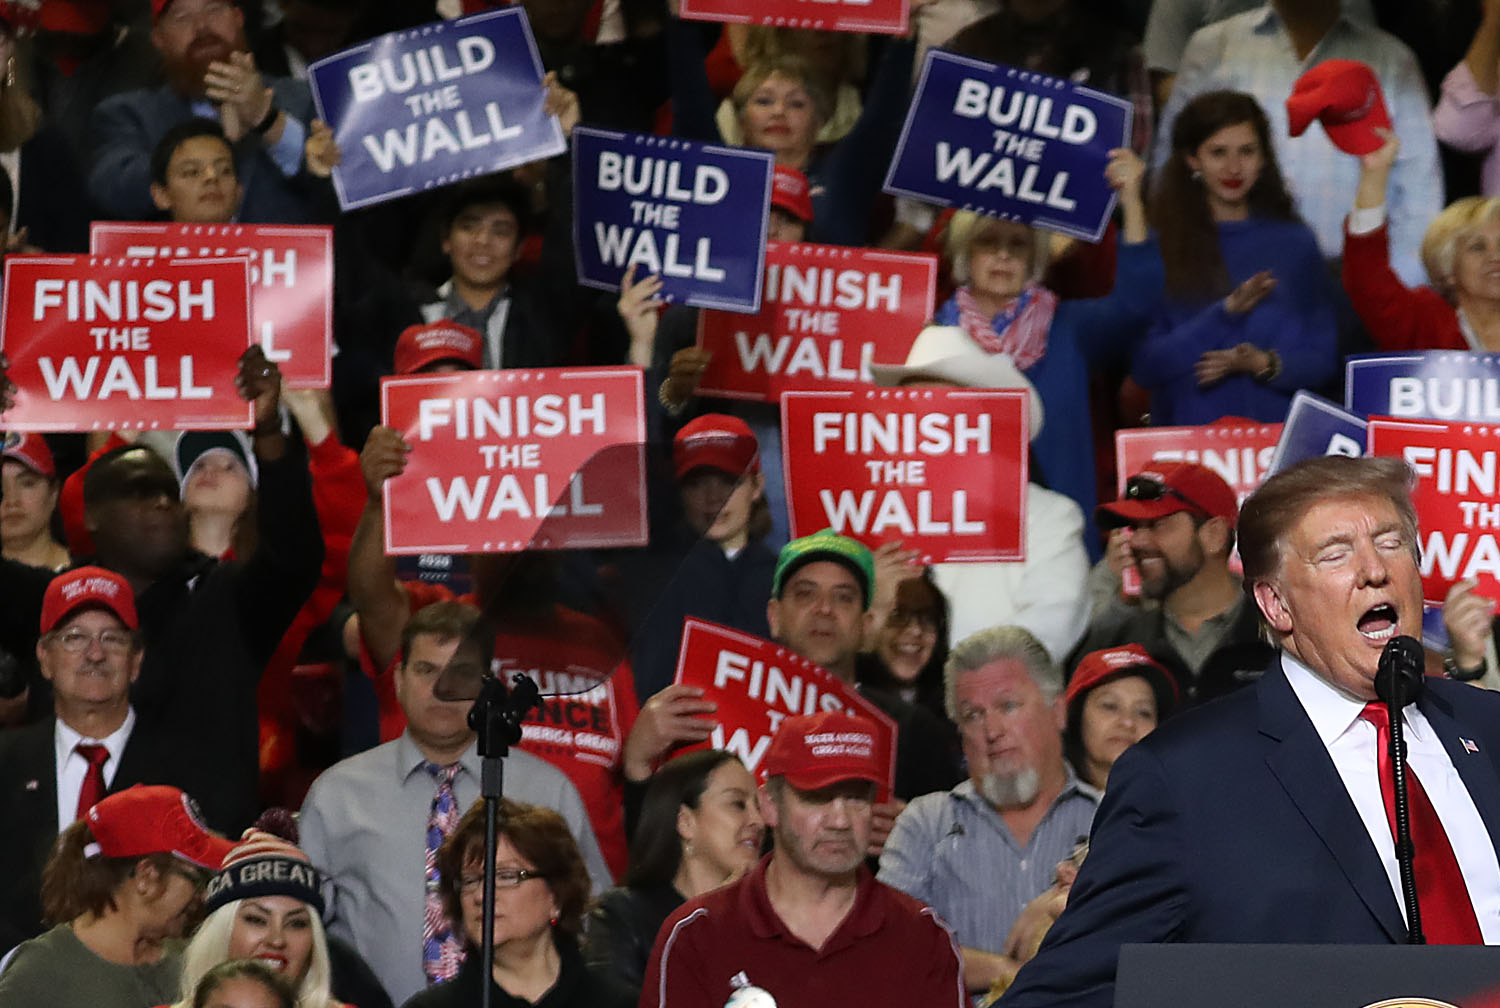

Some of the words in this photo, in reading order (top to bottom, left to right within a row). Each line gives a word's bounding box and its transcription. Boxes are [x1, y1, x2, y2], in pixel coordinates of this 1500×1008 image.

[349, 36, 497, 102] BUILD
[404, 84, 461, 118] THE
[953, 78, 1098, 145] BUILD
[362, 103, 523, 173] WALL
[991, 129, 1044, 161] THE
[598, 152, 730, 204] BUILD
[934, 141, 1076, 211] WALL
[630, 201, 680, 228] THE
[594, 223, 726, 283] WALL
[32, 279, 215, 321] FINISH
[766, 264, 902, 312] INISH
[90, 327, 150, 351] THE
[785, 309, 839, 335] THE
[38, 355, 213, 400] WALL
[419, 394, 608, 441] FINISH
[812, 412, 991, 454] FINISH
[479, 444, 540, 469] THE
[865, 460, 925, 485] THE
[427, 472, 604, 521] WALL
[820, 490, 986, 534] WALL
[240, 860, 316, 888] GREAT
